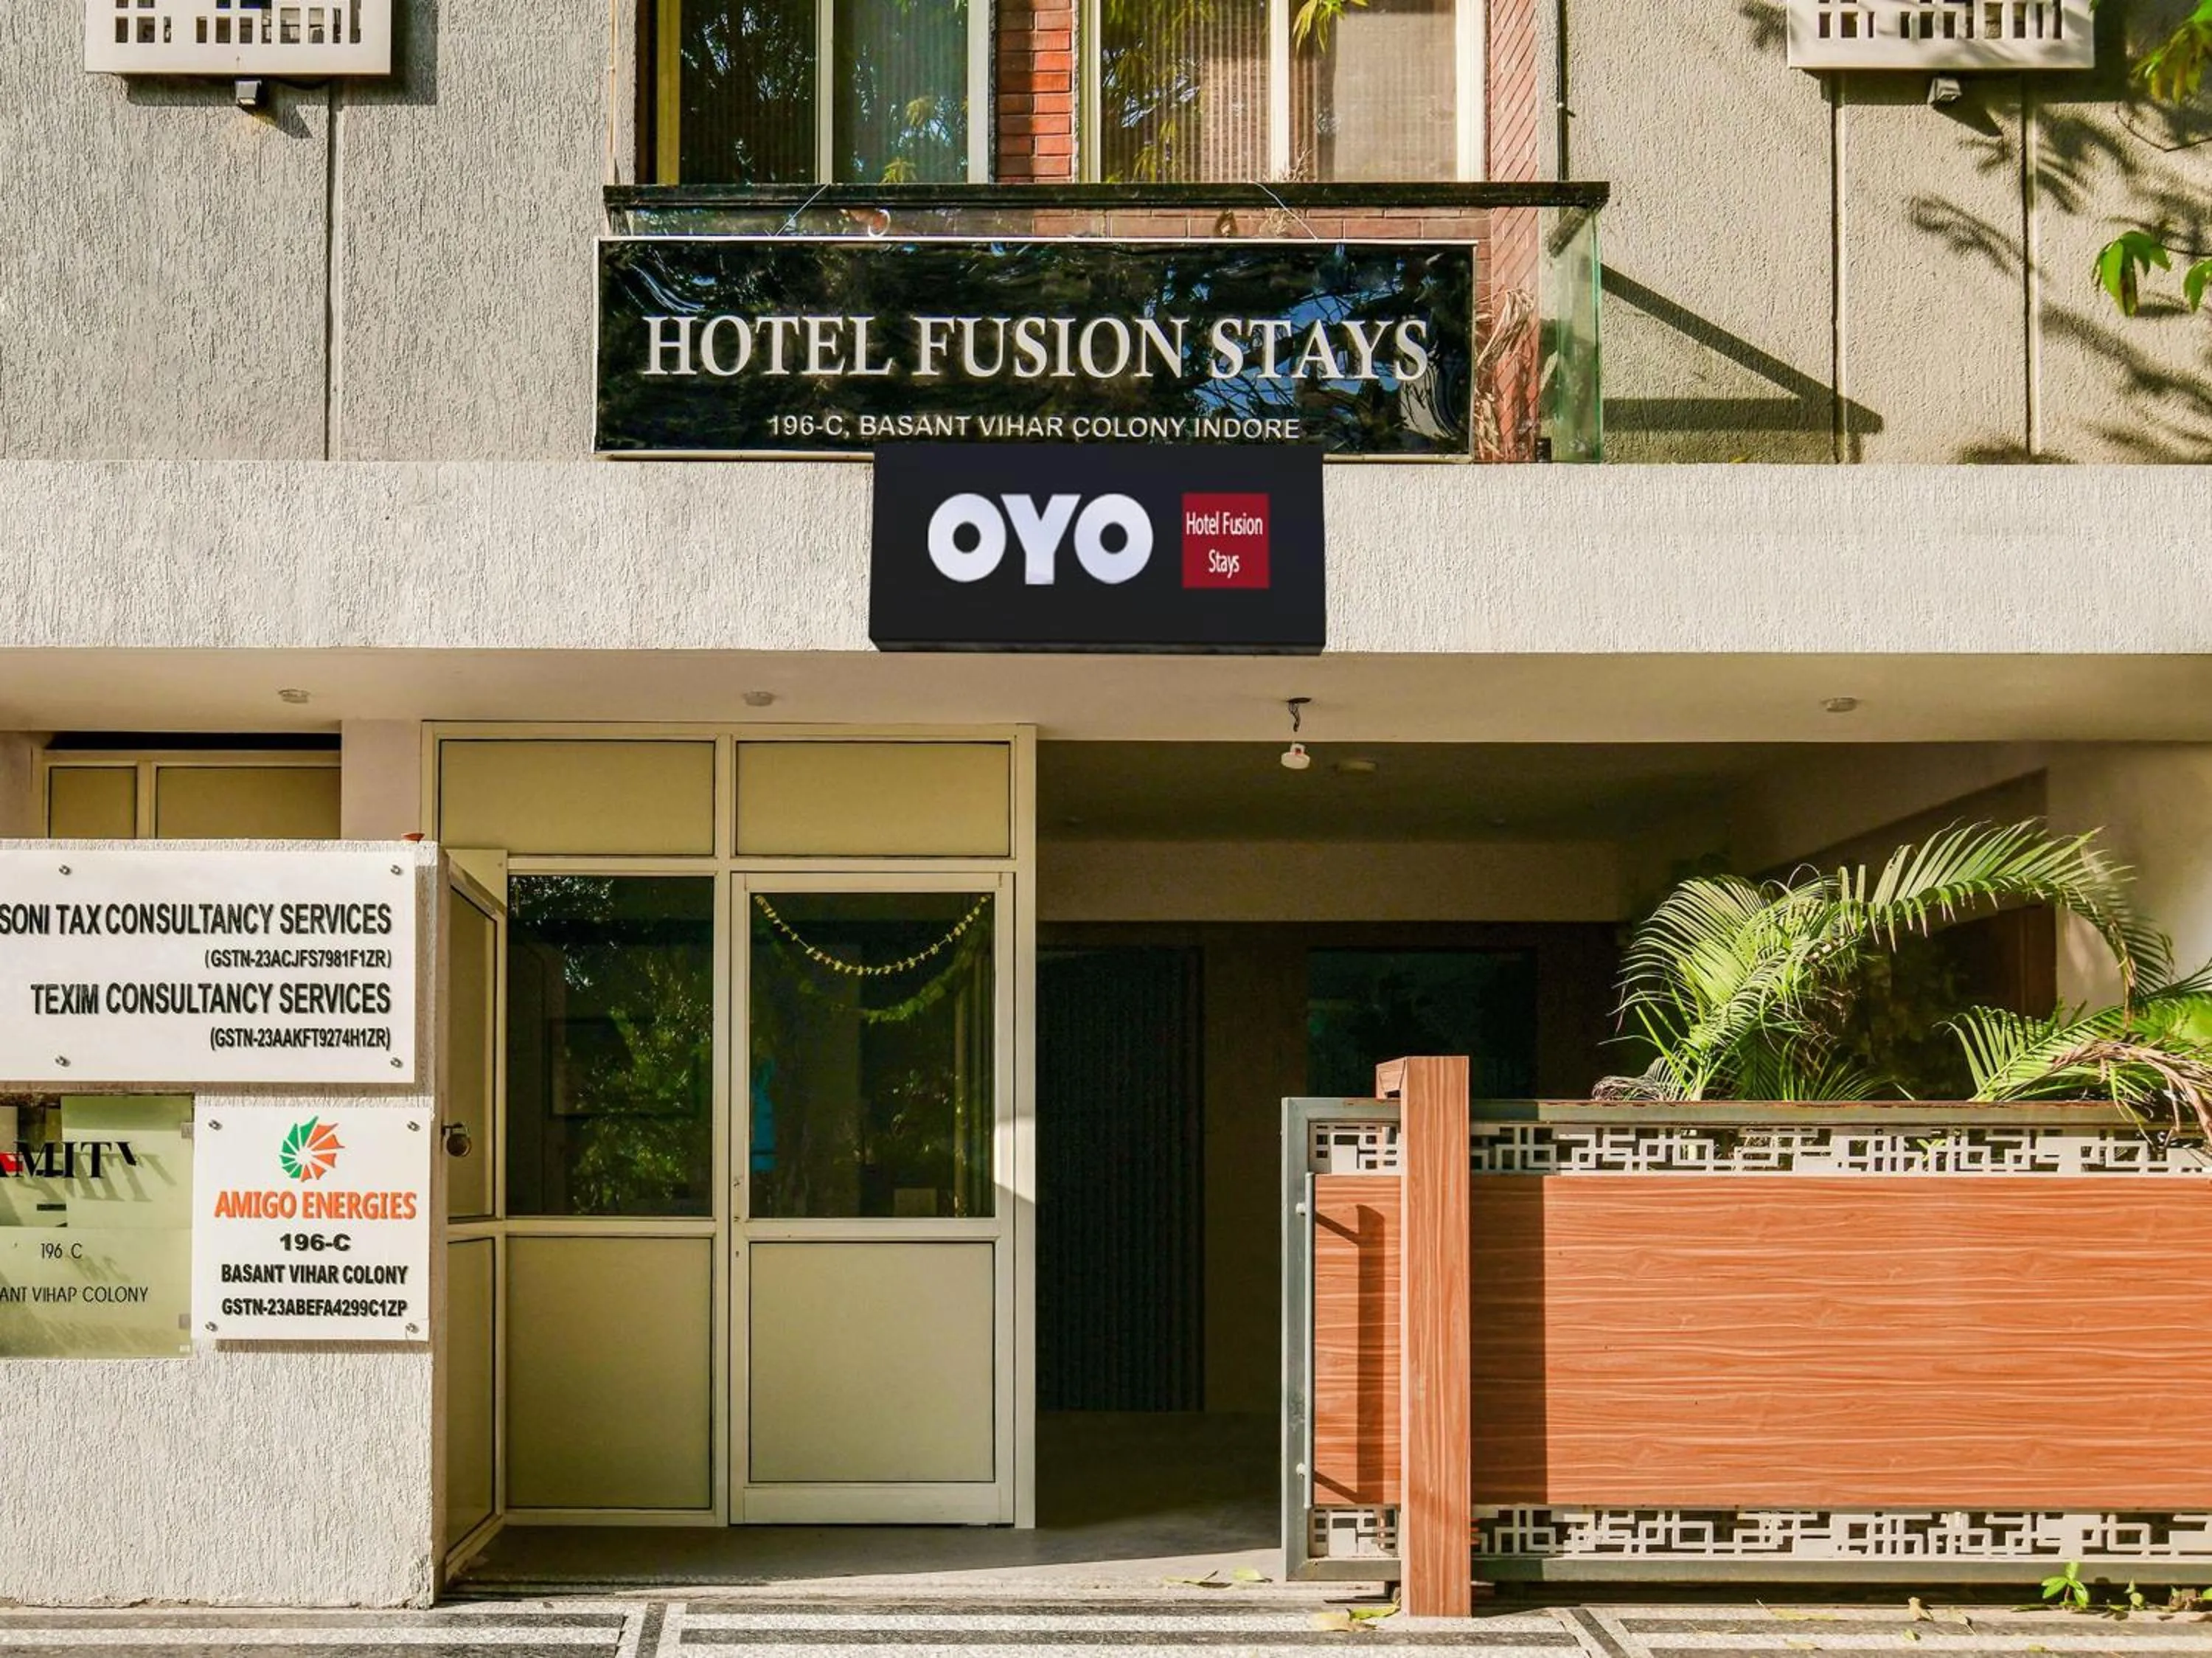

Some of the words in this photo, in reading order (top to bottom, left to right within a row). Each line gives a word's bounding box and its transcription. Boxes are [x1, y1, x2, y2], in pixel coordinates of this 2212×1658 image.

[642, 315, 894, 378] HOTEL
[911, 316, 1190, 379] FUSION
[1210, 318, 1429, 381] STAYS
[767, 415, 850, 439] 196-C,
[860, 416, 972, 437] BASANT
[977, 417, 1064, 437] VIHAR
[1072, 417, 1186, 438] COLONY
[1194, 418, 1300, 439] INDORE
[1186, 510, 1220, 535] Hotel
[1222, 511, 1263, 535] Fusion
[928, 492, 1154, 585] OYO
[1208, 548, 1239, 579] Stays
[0, 903, 50, 934] SONI
[55, 904, 102, 934] TAX
[105, 903, 274, 934] CONSULTANCY
[279, 903, 392, 934] SERVICES
[30, 983, 99, 1014] TEXIM
[105, 982, 274, 1014] CONSULTANCY
[279, 982, 391, 1014] SERVICES
[214, 1190, 297, 1218] AMIGO
[302, 1191, 417, 1220] ENERGIES
[41, 1243, 63, 1259] 196
[71, 1243, 83, 1259] C
[279, 1232, 351, 1252] 196-C
[221, 1263, 285, 1283] BASANT
[289, 1265, 339, 1284] VIHAR
[343, 1265, 408, 1284] COLONY
[82, 1286, 149, 1303] COLONY
